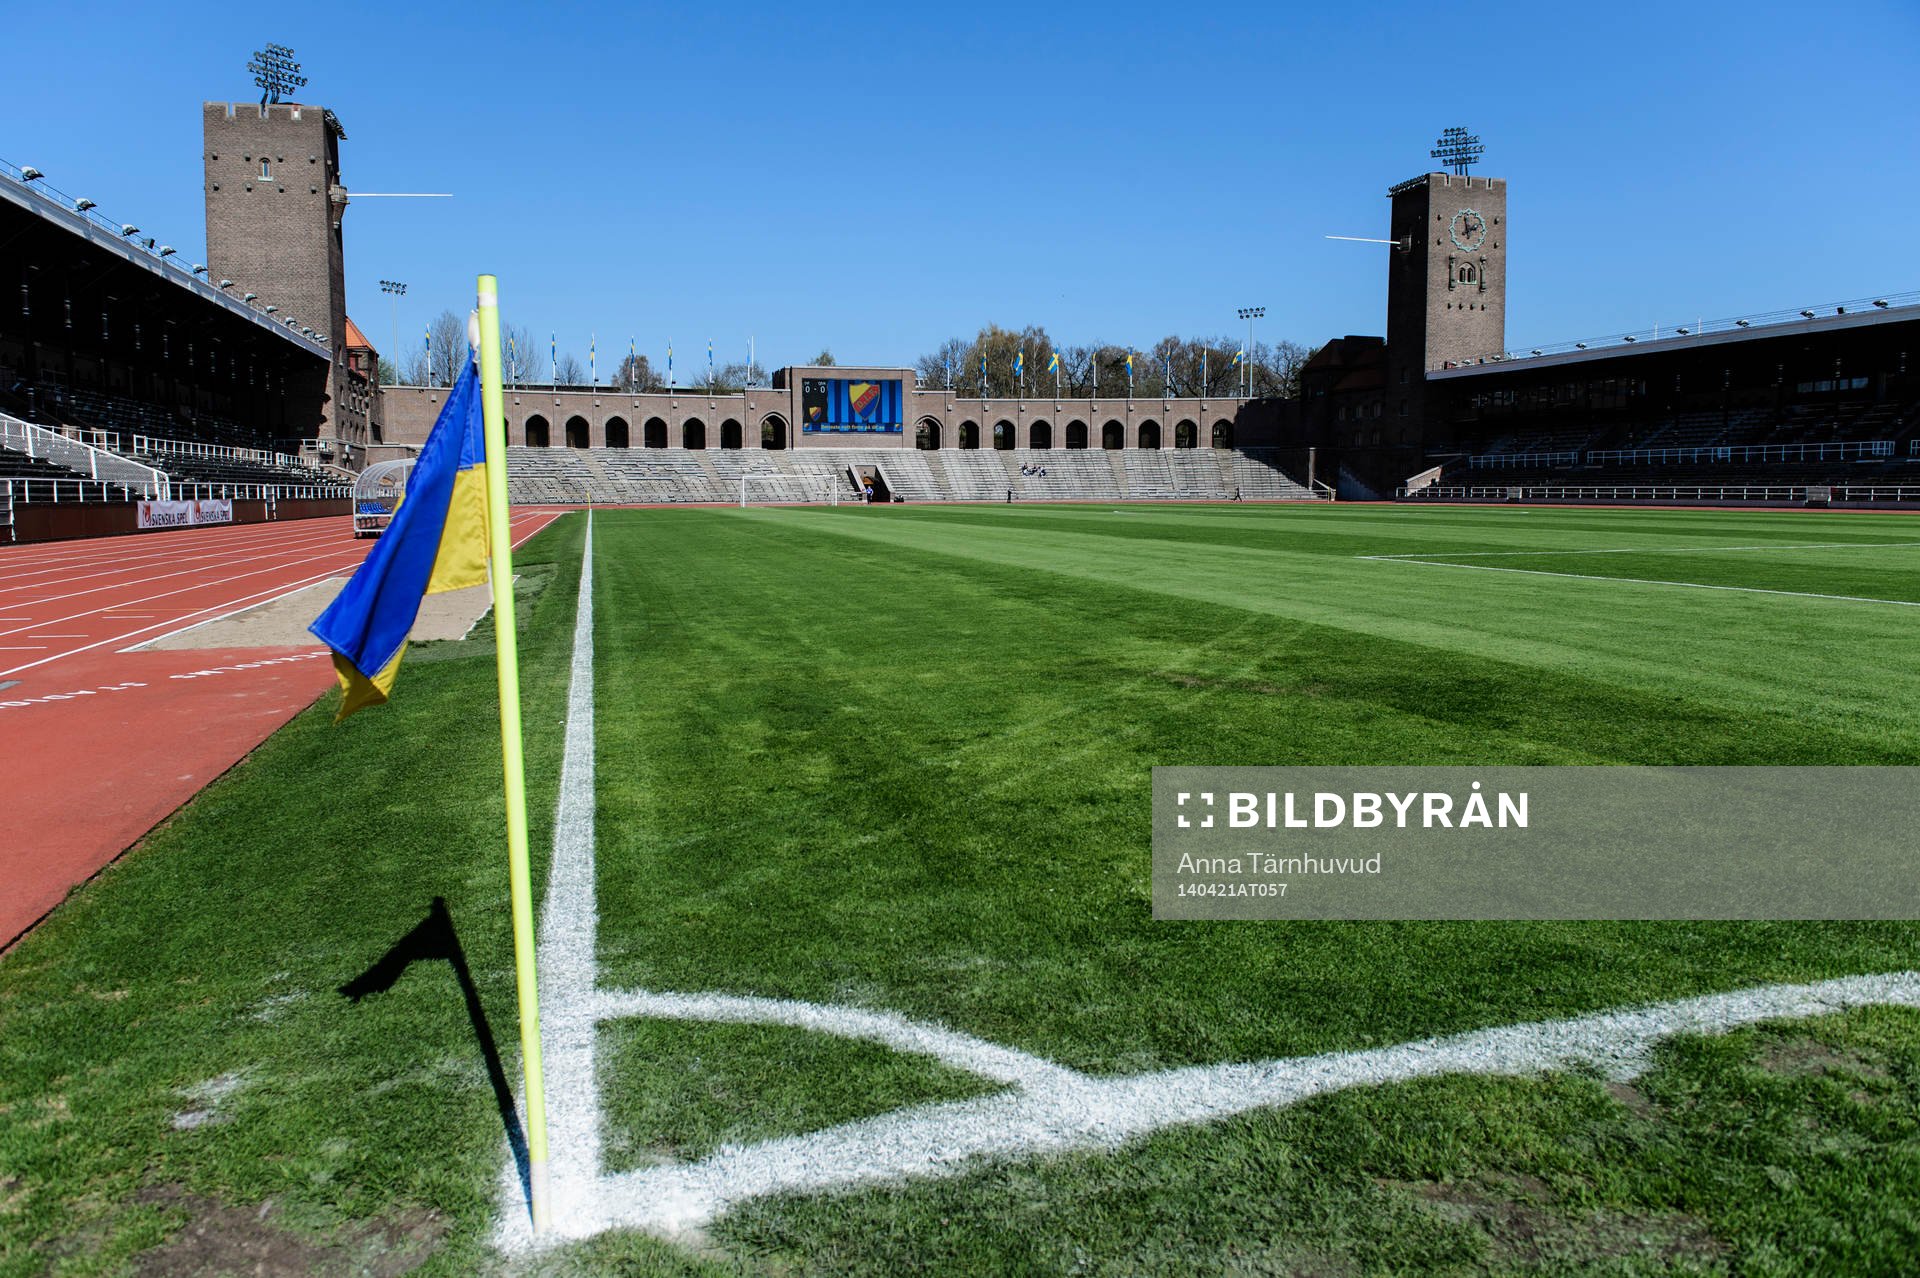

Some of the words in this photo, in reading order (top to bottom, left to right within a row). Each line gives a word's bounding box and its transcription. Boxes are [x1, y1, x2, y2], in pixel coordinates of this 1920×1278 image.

[151, 513, 175, 527] SVENSKA
[176, 512, 188, 525] SPEL
[200, 510, 220, 523] SVENSKA
[220, 510, 230, 521] SPEL
[0, 682, 149, 709] STADIO
